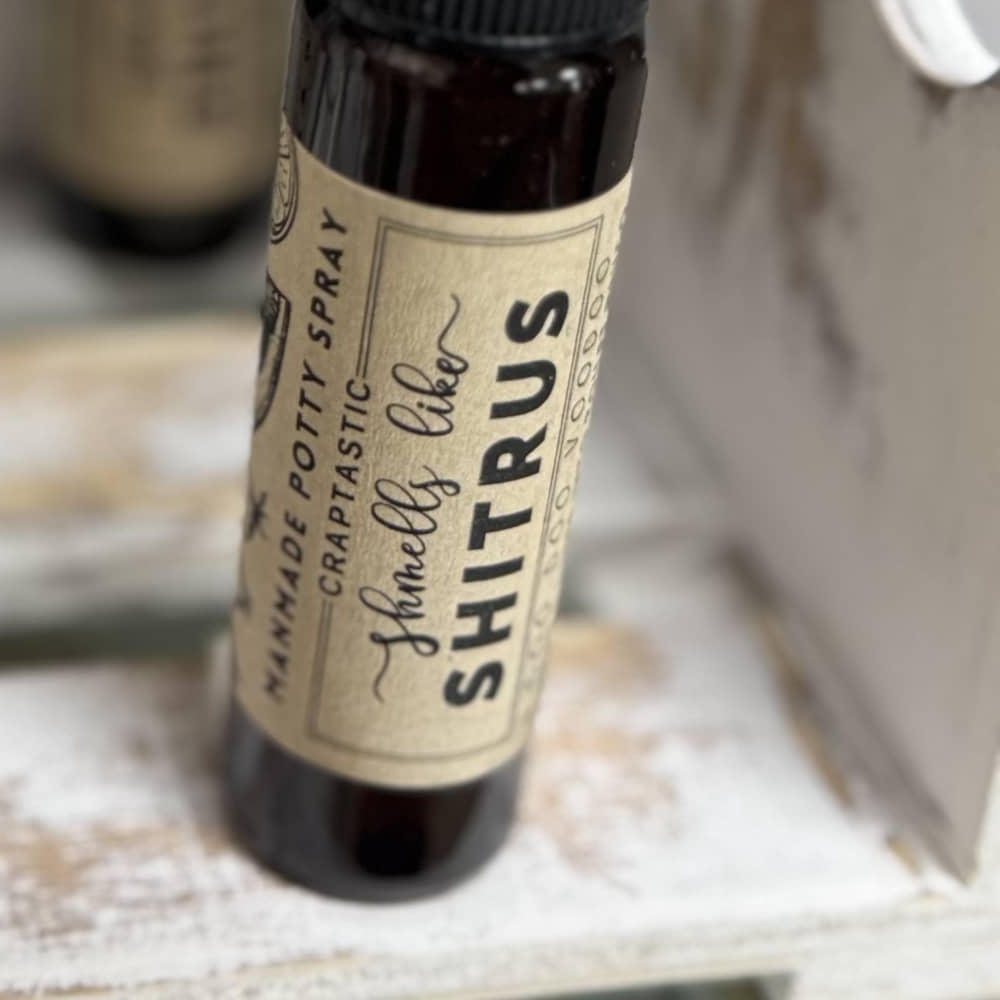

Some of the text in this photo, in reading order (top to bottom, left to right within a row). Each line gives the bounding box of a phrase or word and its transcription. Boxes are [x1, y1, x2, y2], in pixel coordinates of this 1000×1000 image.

[265, 208, 348, 700] MANMADE POTTY SPRAY
[319, 378, 371, 597] CRAPTASTIC
[386, 293, 468, 436] like
[443, 290, 570, 706] SHITRUS
